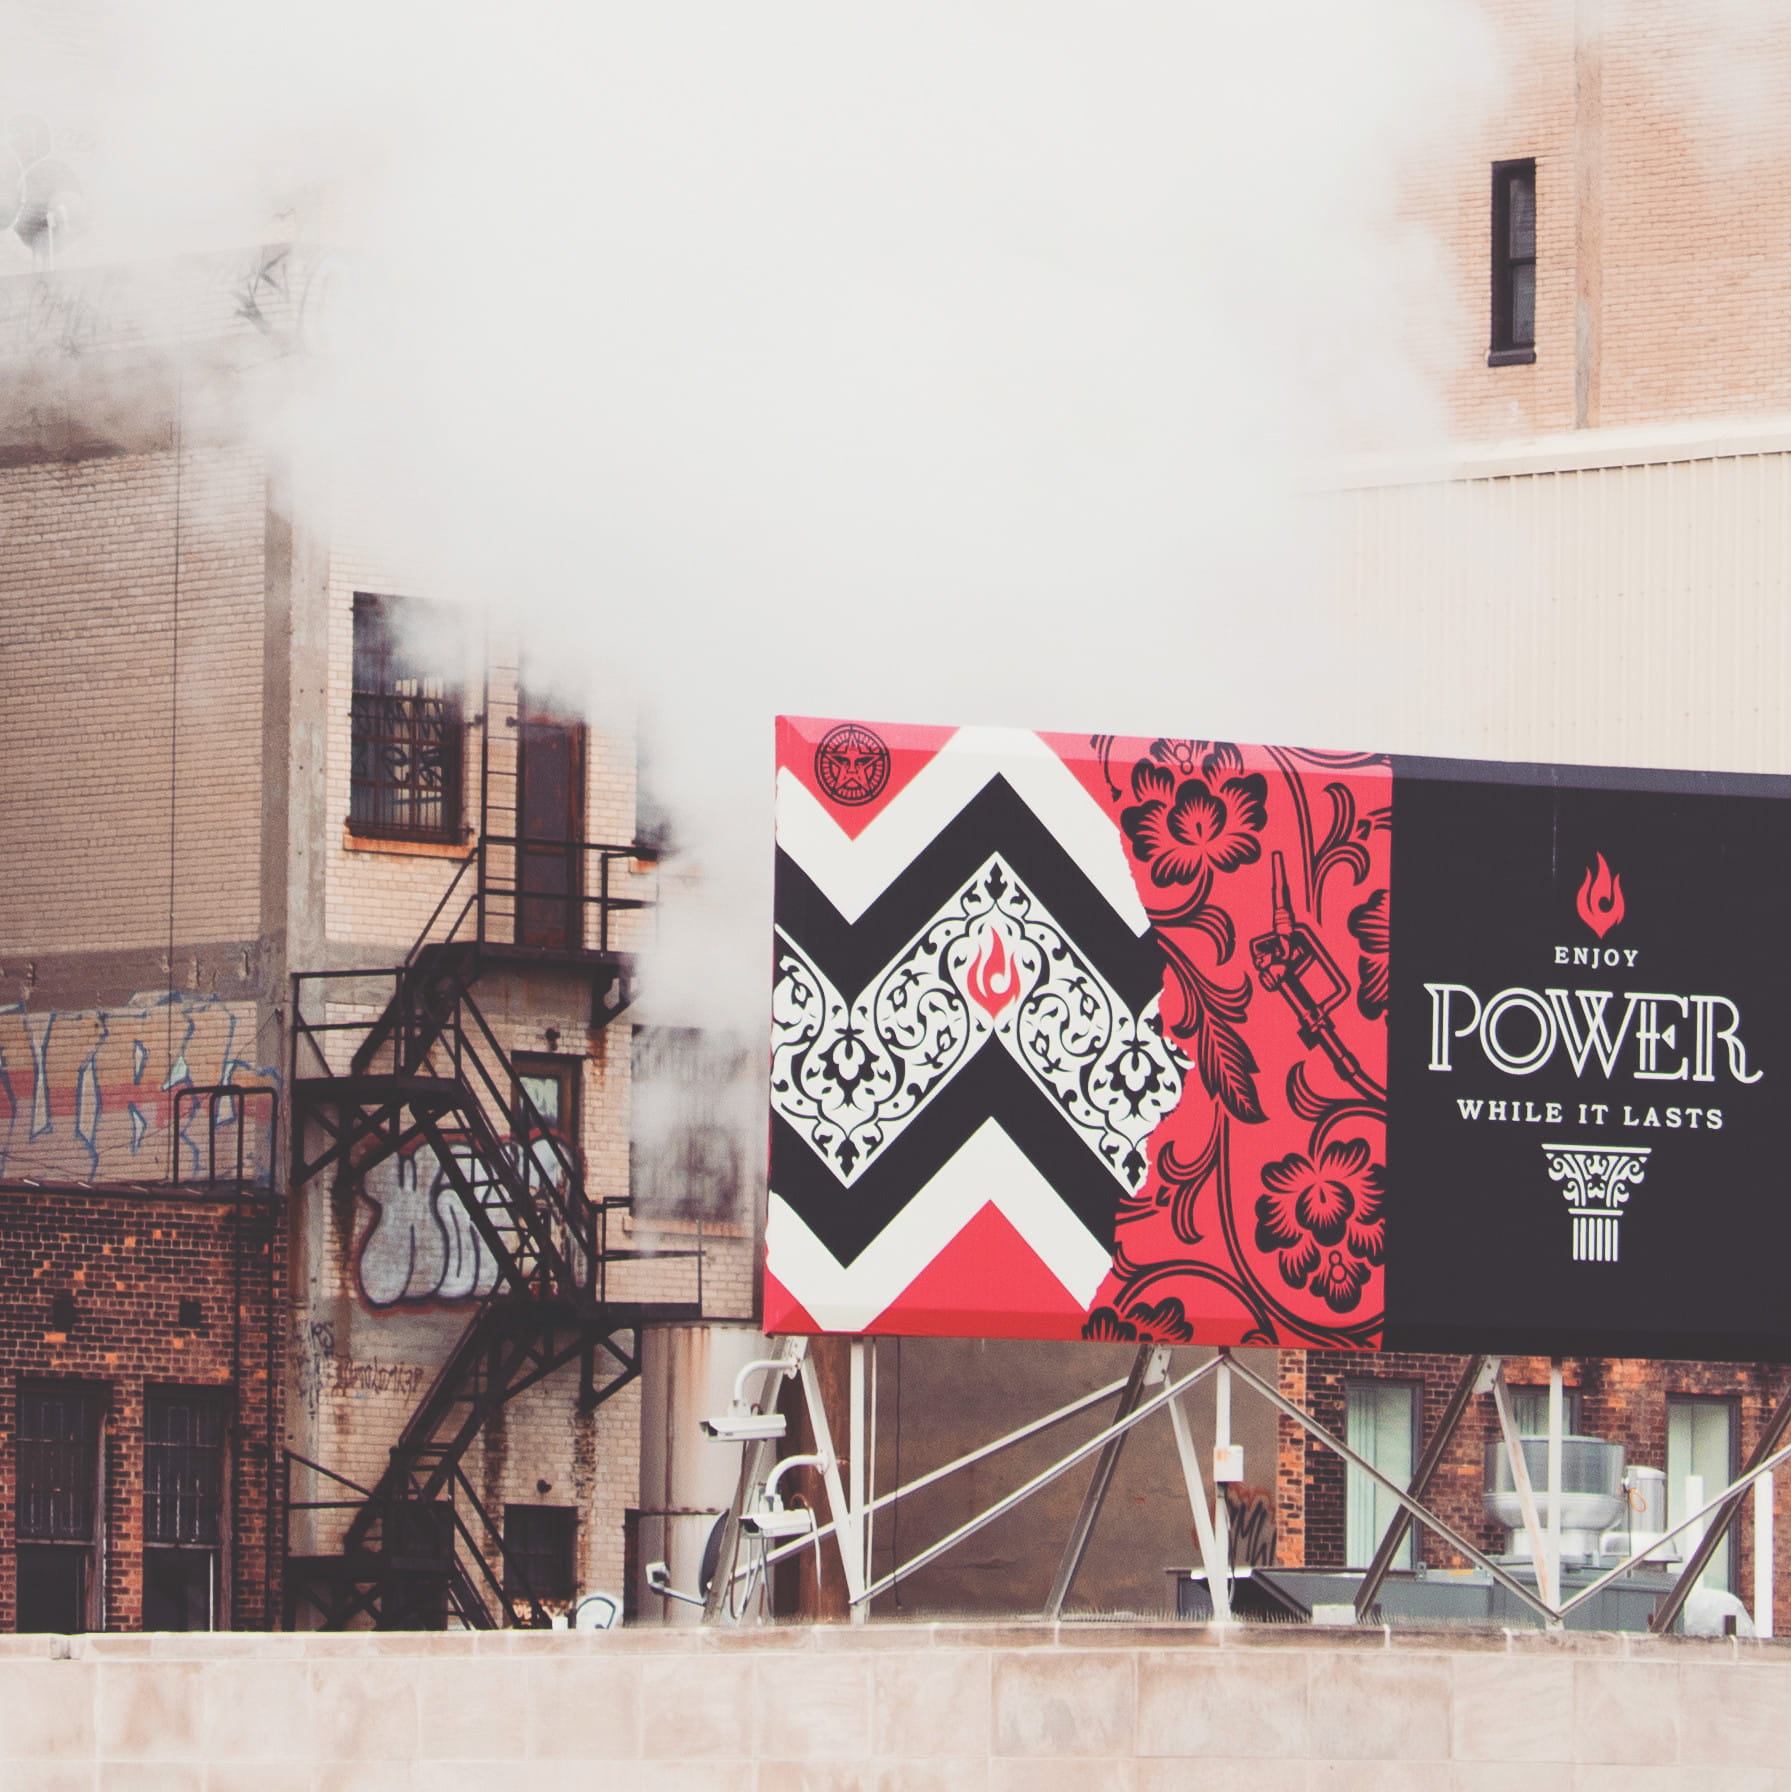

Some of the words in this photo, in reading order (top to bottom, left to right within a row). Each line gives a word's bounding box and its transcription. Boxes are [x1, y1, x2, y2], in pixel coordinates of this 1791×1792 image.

[1554, 946, 1639, 969] ENJOY
[1422, 983, 1764, 1085] POWER
[1457, 1098, 1564, 1123] WHILE
[1578, 1103, 1609, 1126] IT
[1623, 1105, 1724, 1130] LASTS
